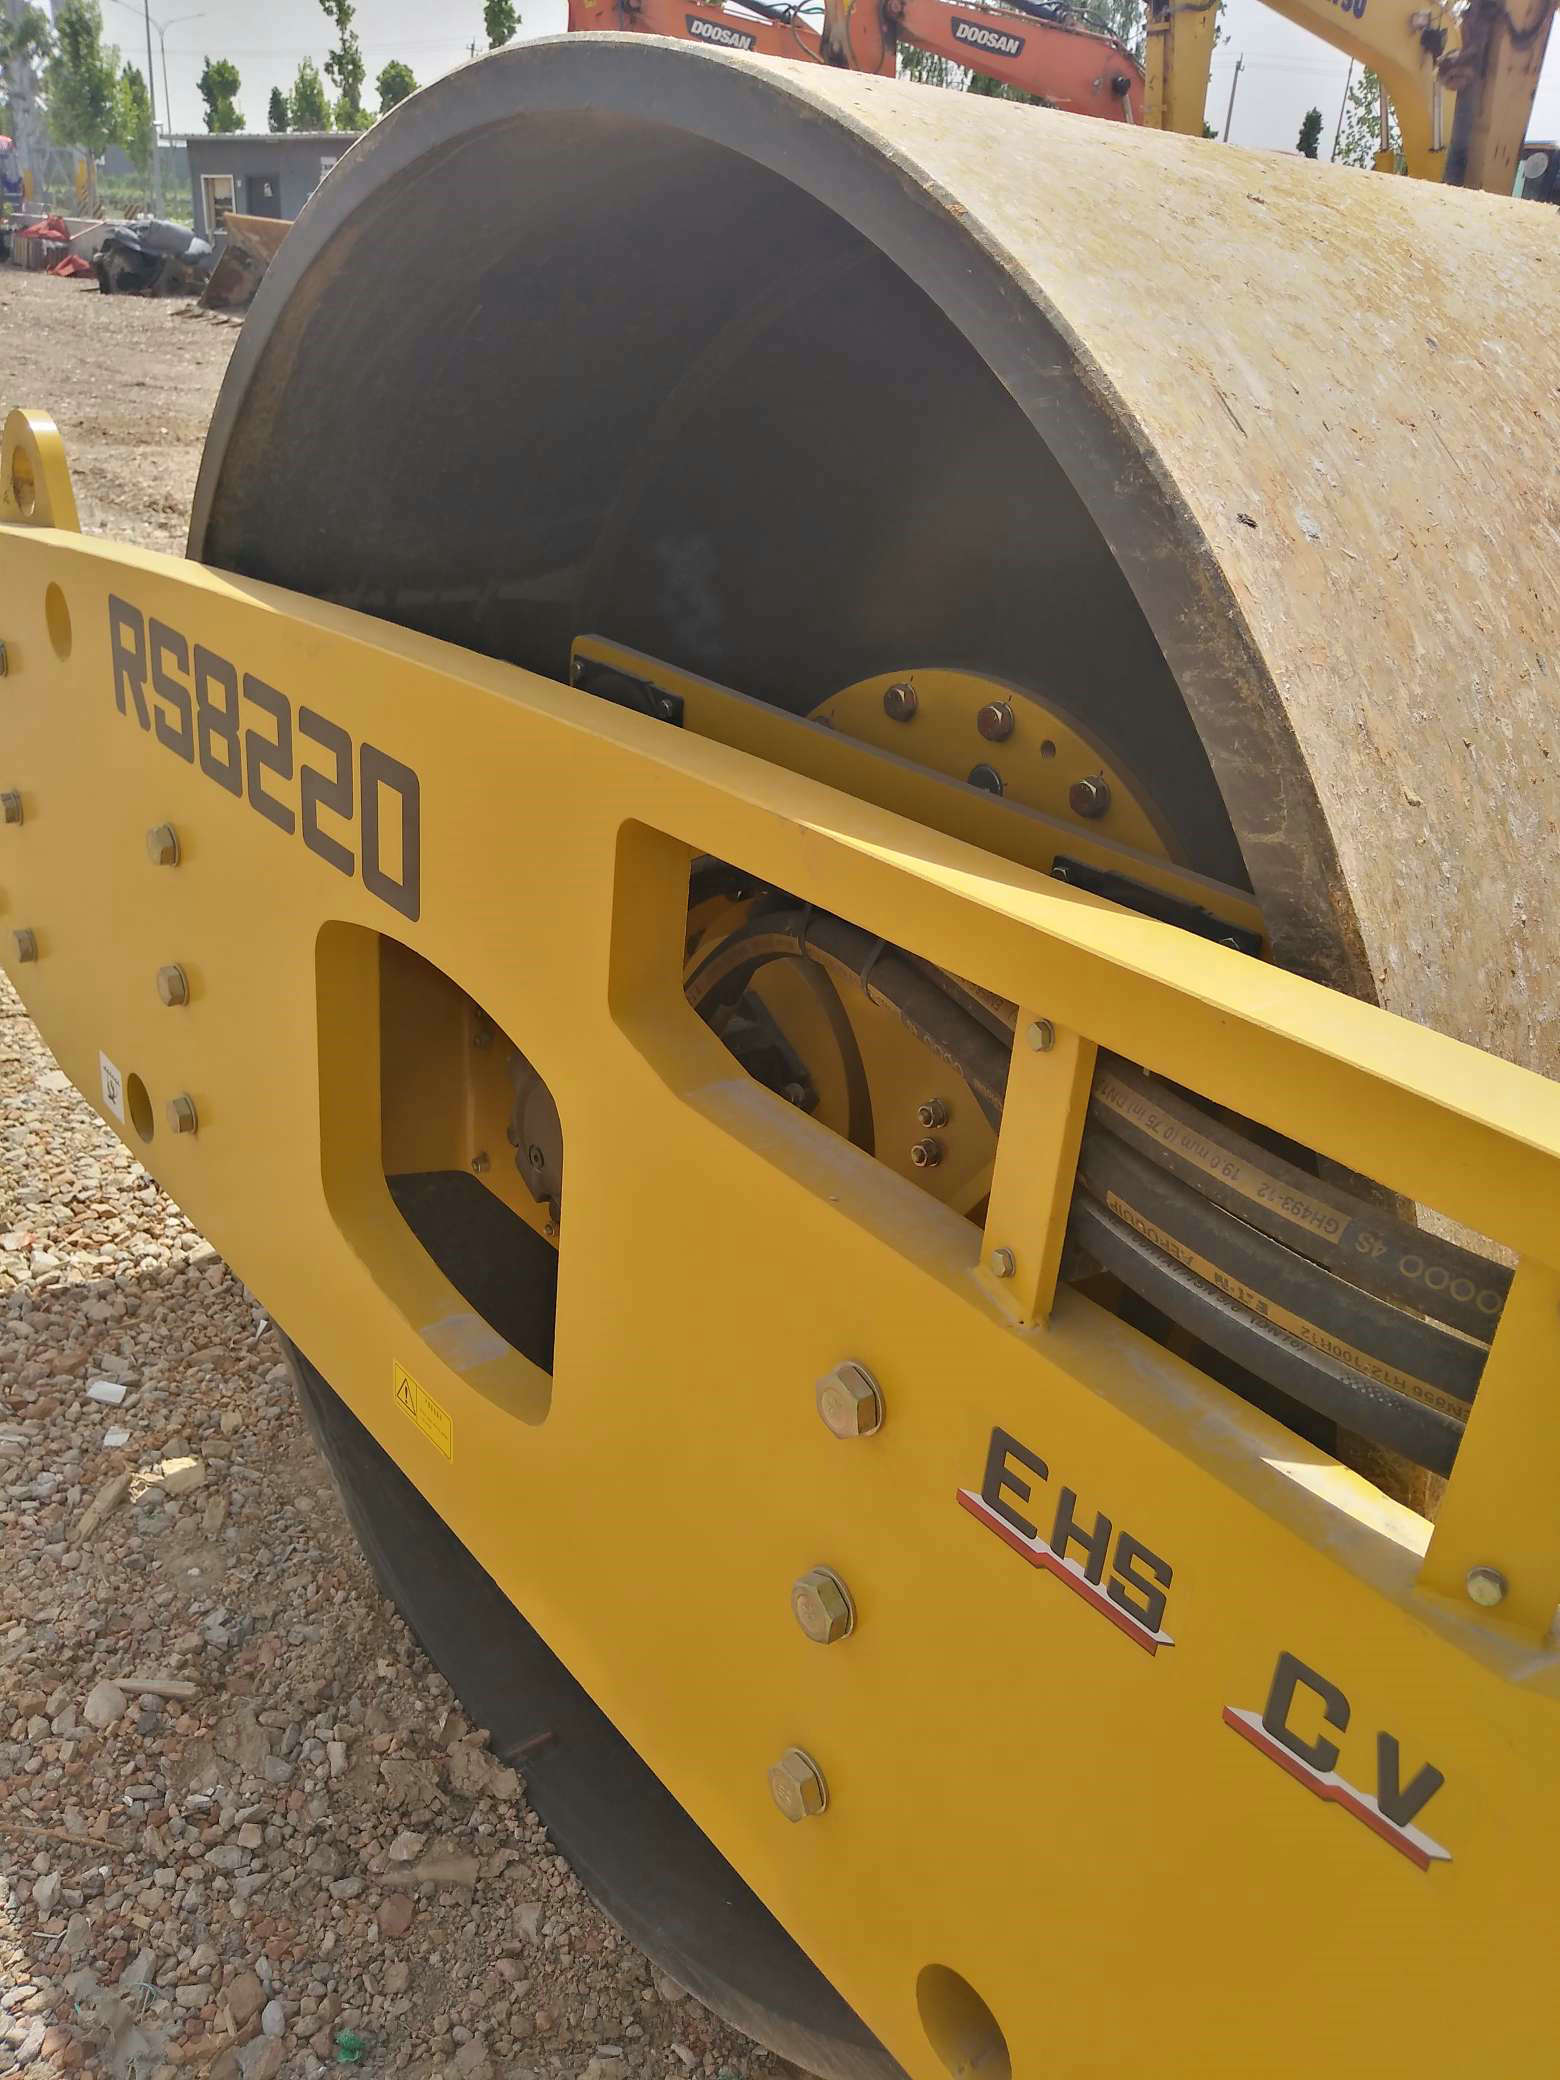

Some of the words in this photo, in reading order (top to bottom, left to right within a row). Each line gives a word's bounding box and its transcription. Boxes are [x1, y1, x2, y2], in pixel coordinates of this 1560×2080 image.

[690, 19, 752, 51] DOOSAN
[955, 23, 1021, 54] DOOSAN
[108, 593, 421, 922] RS8220
[981, 1426, 1174, 1634] EHS
[1262, 1651, 1446, 1828] CV
